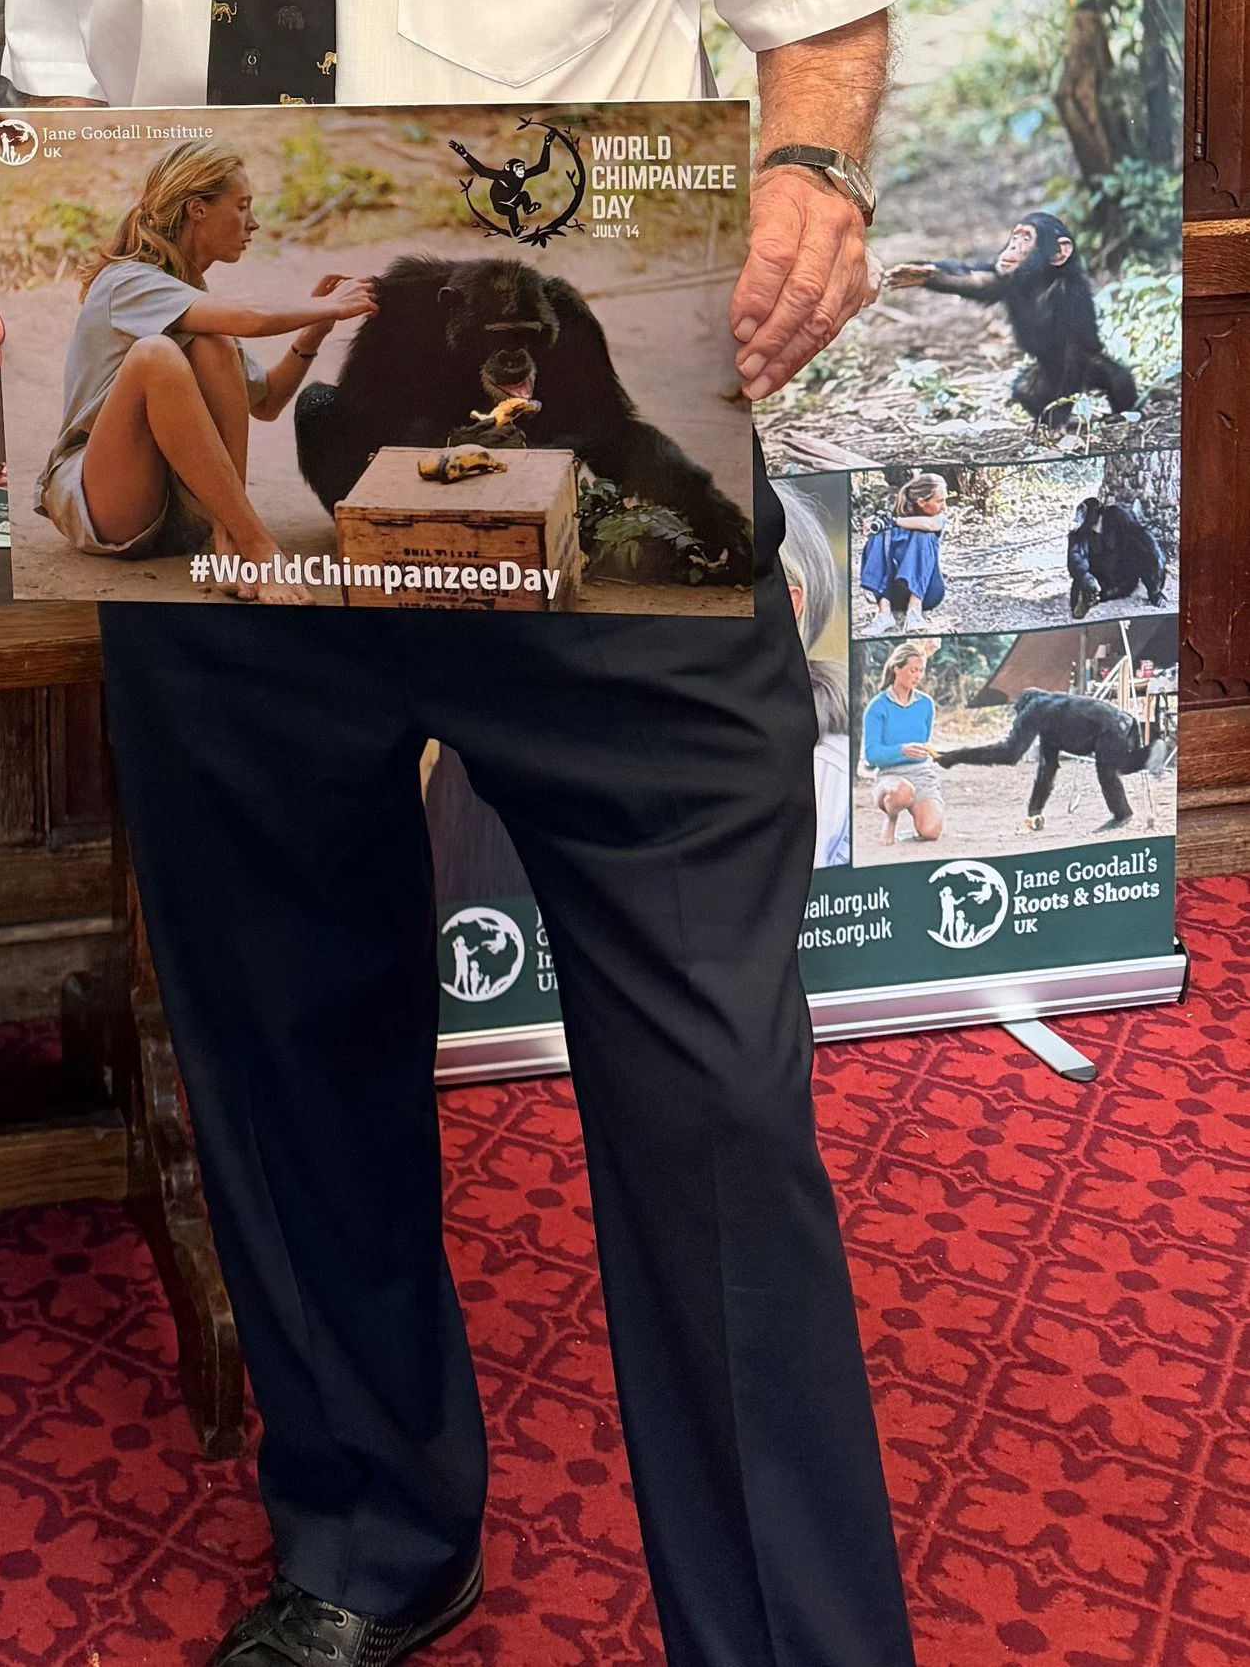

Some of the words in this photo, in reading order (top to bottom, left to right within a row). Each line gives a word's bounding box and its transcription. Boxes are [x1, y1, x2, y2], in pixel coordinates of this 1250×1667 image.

[42, 127, 76, 143] Jane
[81, 125, 141, 141] Goodall
[146, 124, 213, 139] Institute
[43, 147, 62, 158] UK
[591, 135, 672, 161] WORLD
[591, 164, 737, 191] CHIMPANZEE
[592, 195, 635, 219] DAY
[591, 224, 622, 238] JULY
[625, 224, 640, 238] 14
[190, 552, 561, 600] #WorldChimpanzeeDay
[1014, 869, 1060, 895] Jane
[1066, 847, 1158, 883] Goodall’s
[1013, 892, 1069, 915] Roots
[1073, 887, 1089, 907] &
[1093, 881, 1160, 904] Shoots
[1013, 918, 1038, 934] UK
